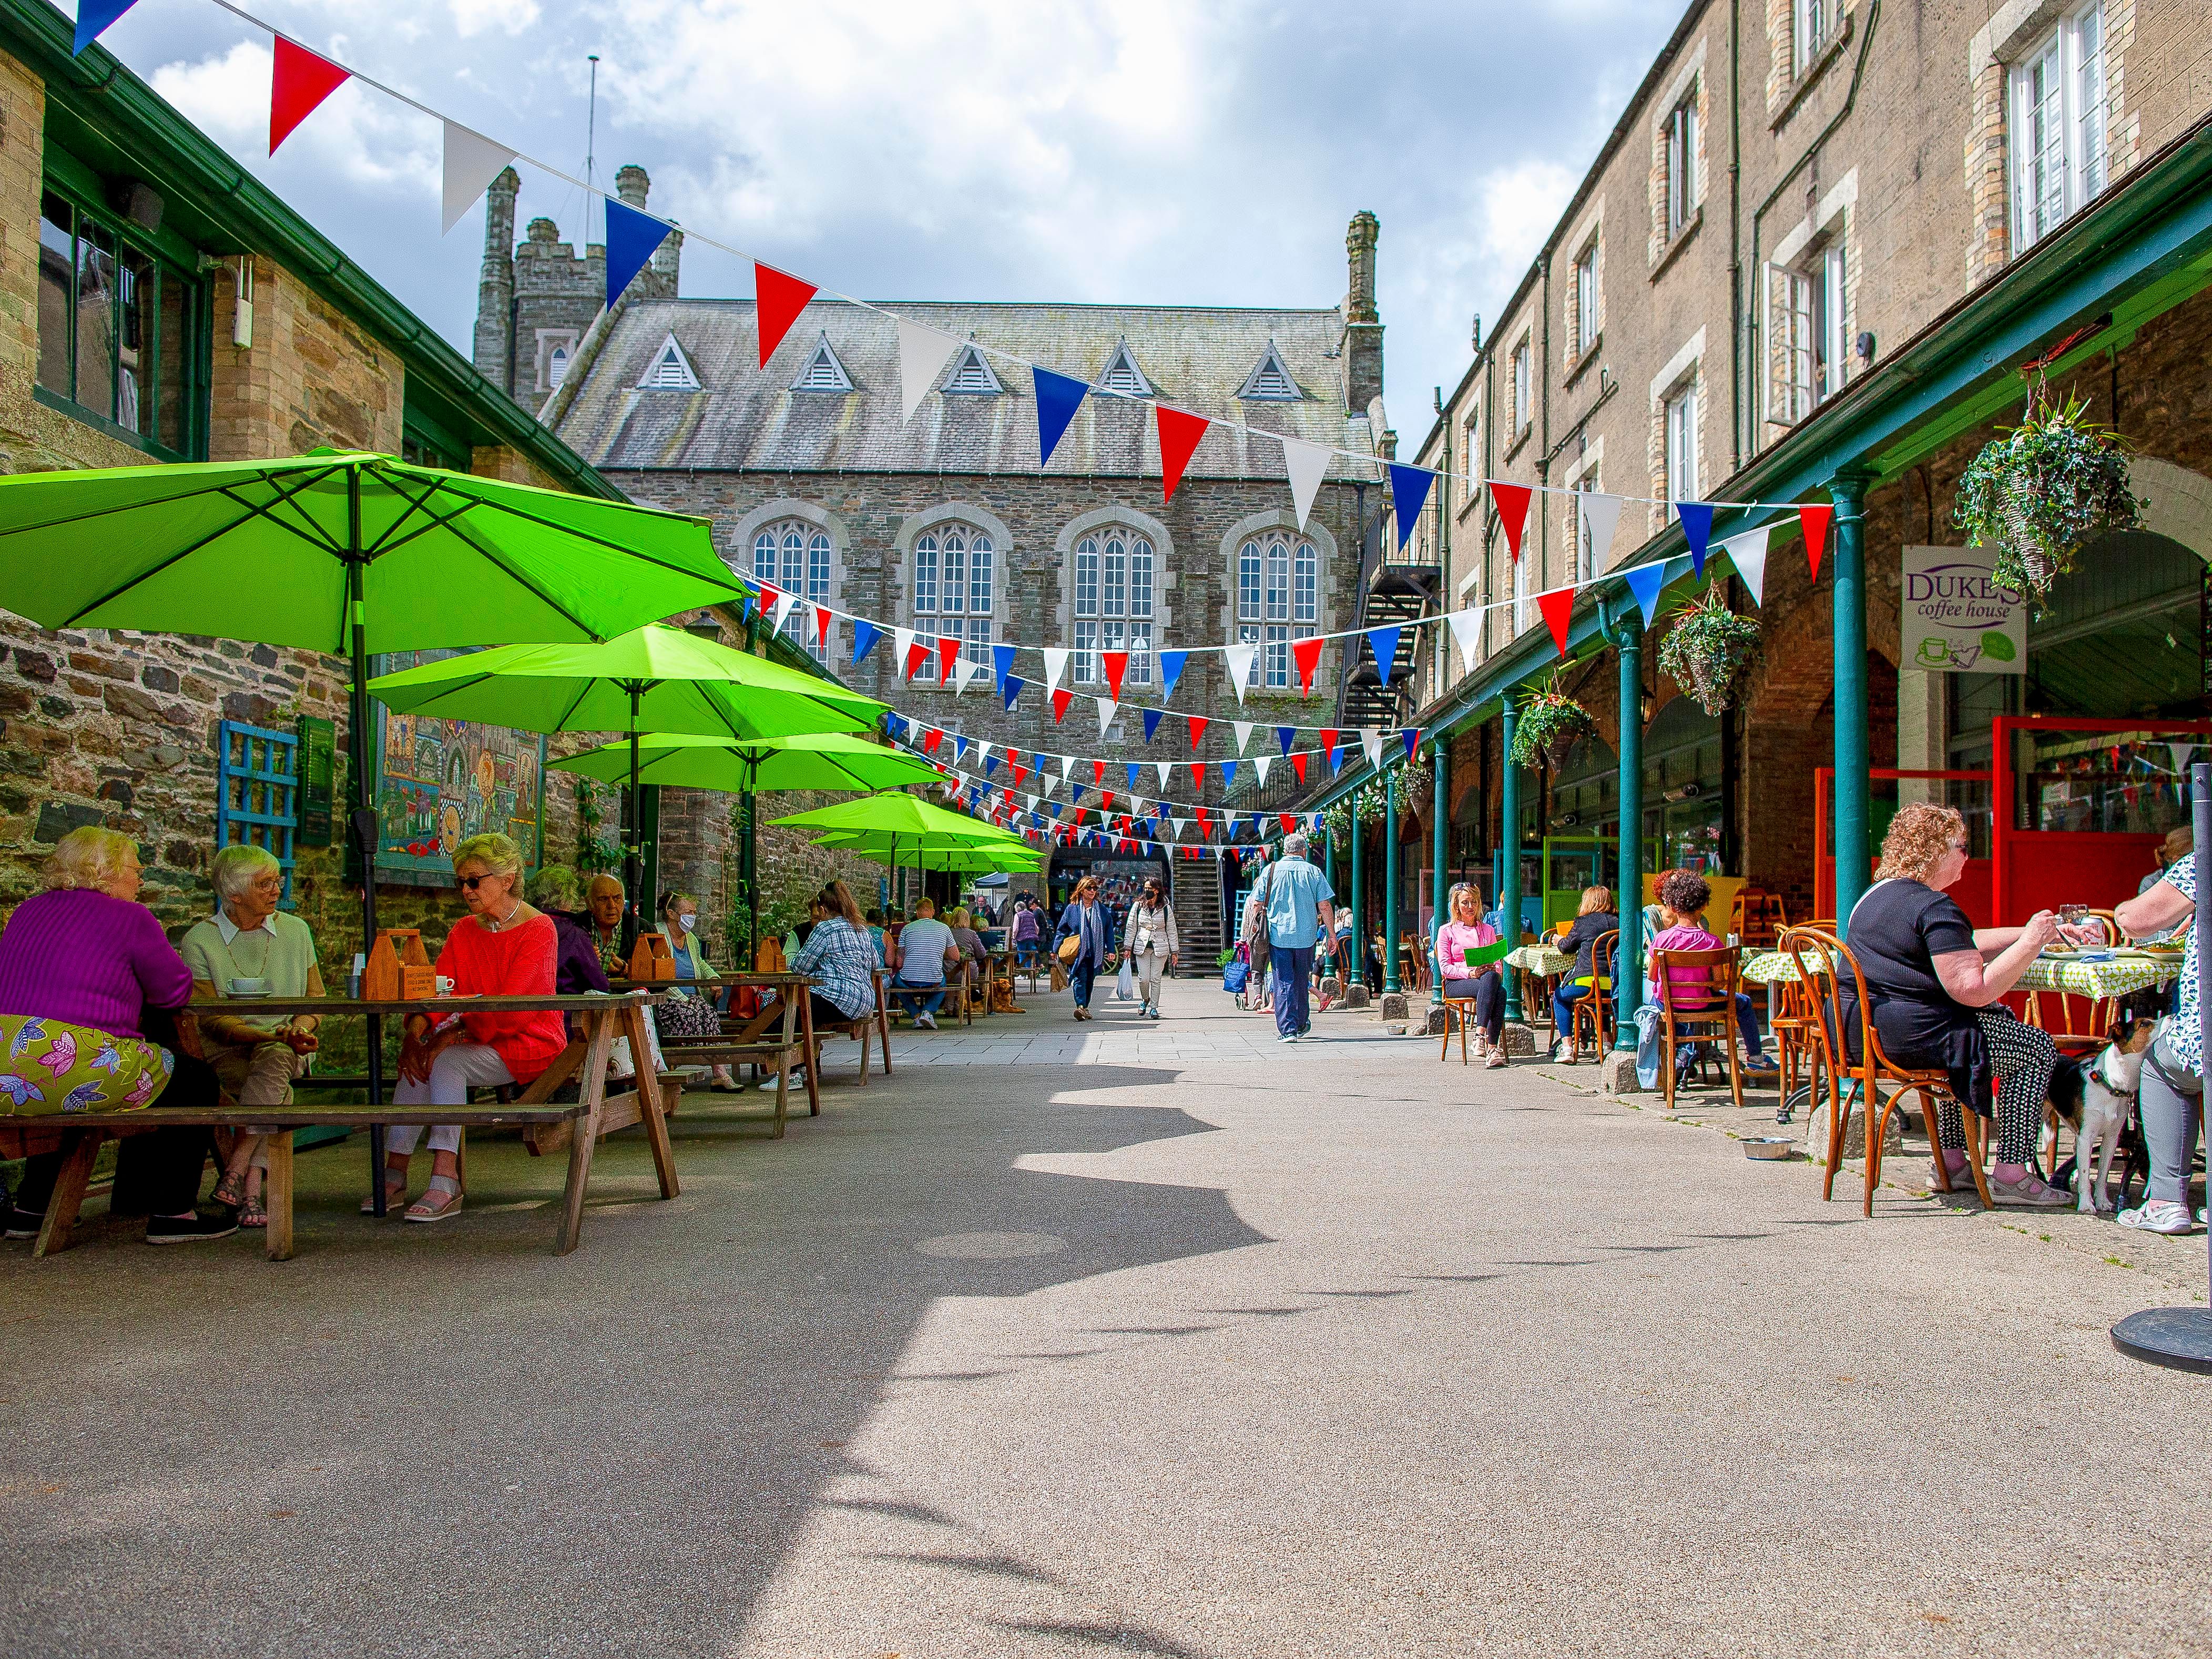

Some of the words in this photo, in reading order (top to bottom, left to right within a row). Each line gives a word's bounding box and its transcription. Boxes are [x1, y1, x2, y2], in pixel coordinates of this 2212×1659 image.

[1907, 573, 2021, 604] DUKES
[1918, 599, 1962, 620] coffee
[1966, 601, 2010, 618] house
